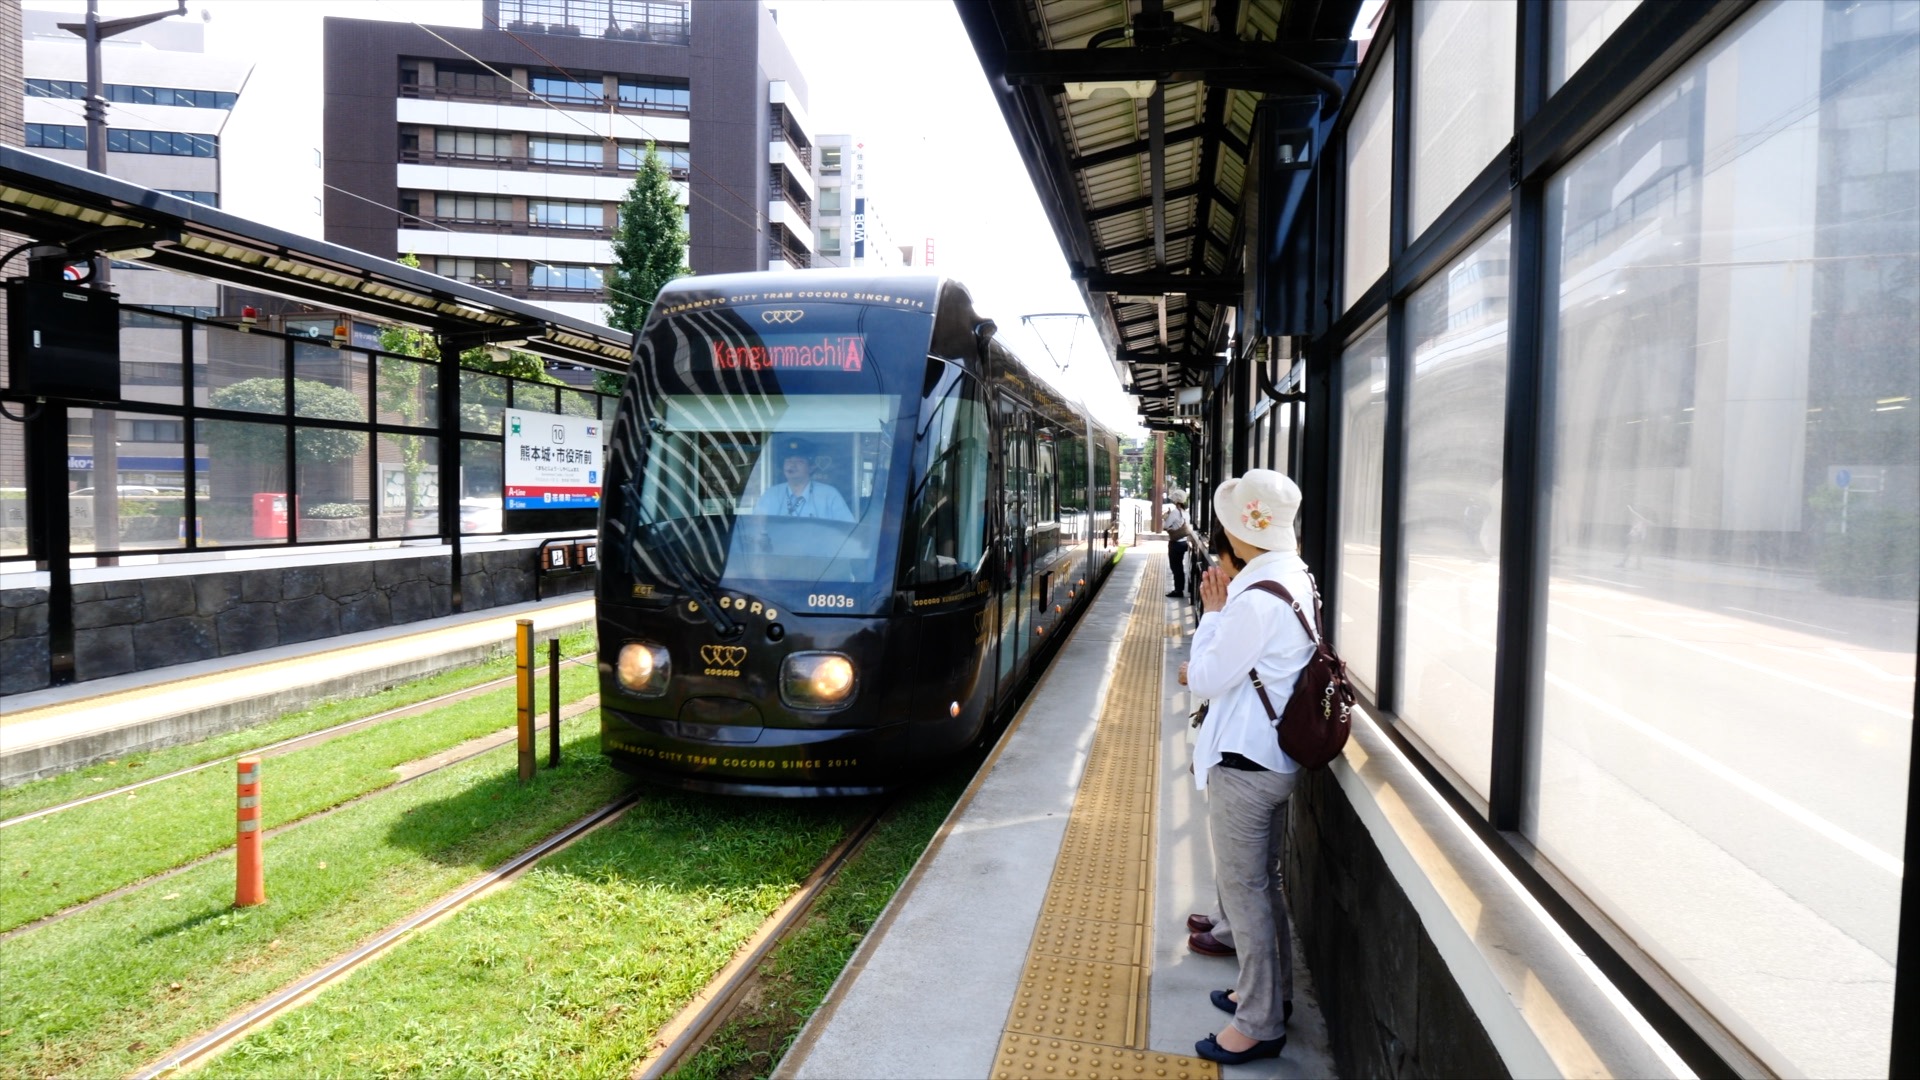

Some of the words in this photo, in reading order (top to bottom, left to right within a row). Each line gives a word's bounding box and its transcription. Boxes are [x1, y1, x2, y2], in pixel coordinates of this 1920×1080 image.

[855, 214, 864, 242] WDB
[662, 298, 725, 315] KUMAMOTO
[731, 294, 758, 302] CITY
[798, 291, 848, 299] COCORO
[854, 293, 890, 302] SINCE
[896, 297, 924, 308] 2014
[713, 338, 841, 370] Kengunmachi
[554, 429, 563, 440] 10
[520, 445, 592, 465] 熊本城・市役所前
[635, 586, 652, 594] KCT
[688, 596, 778, 621] CCORO
[704, 668, 740, 678] COCORO
[658, 752, 682, 762] CITY
[687, 755, 717, 765] TRAM
[723, 758, 775, 769] COCORO
[782, 759, 821, 769] SINCE
[828, 758, 857, 768] 2014
